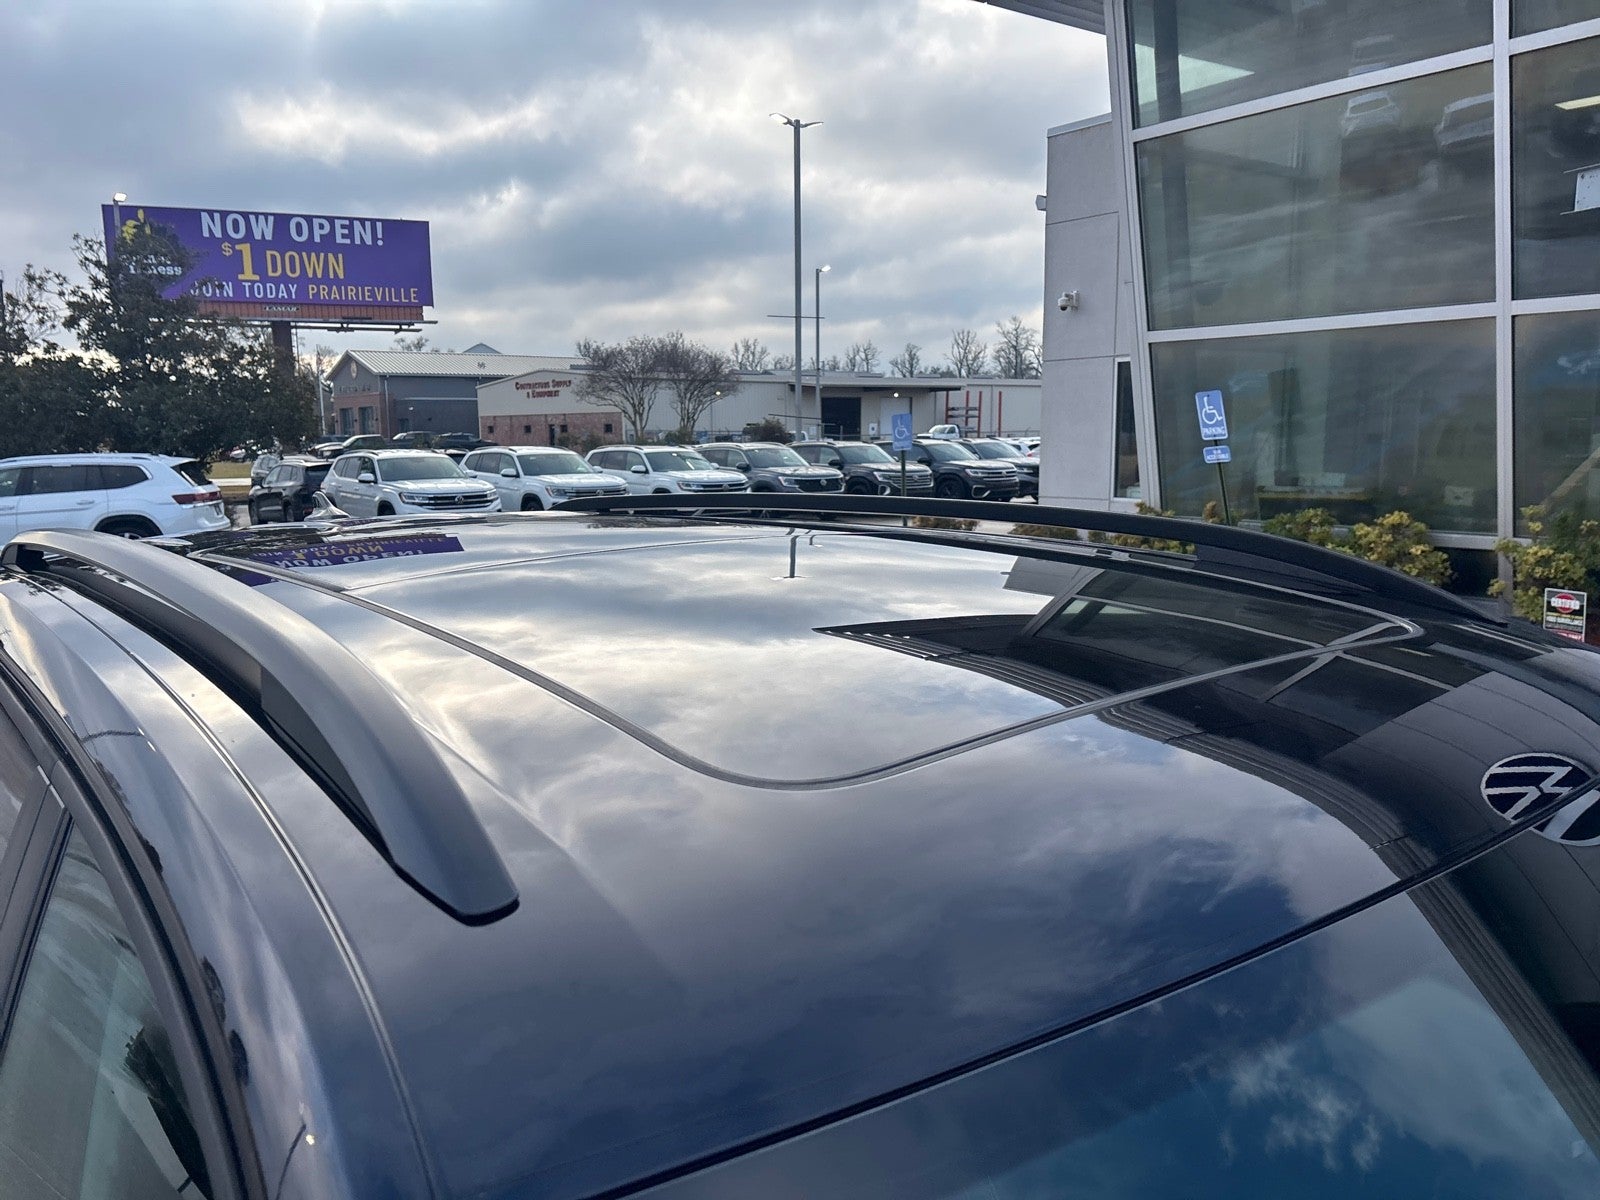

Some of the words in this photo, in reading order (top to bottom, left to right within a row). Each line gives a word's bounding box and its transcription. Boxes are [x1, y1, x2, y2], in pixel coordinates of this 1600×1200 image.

[200, 211, 275, 242] NOW
[289, 216, 384, 246] OPEN!
[221, 242, 260, 281] $1
[265, 250, 345, 279] DOWN
[242, 281, 298, 300] TODAY
[308, 284, 419, 303] PRAIRIEVILLE
